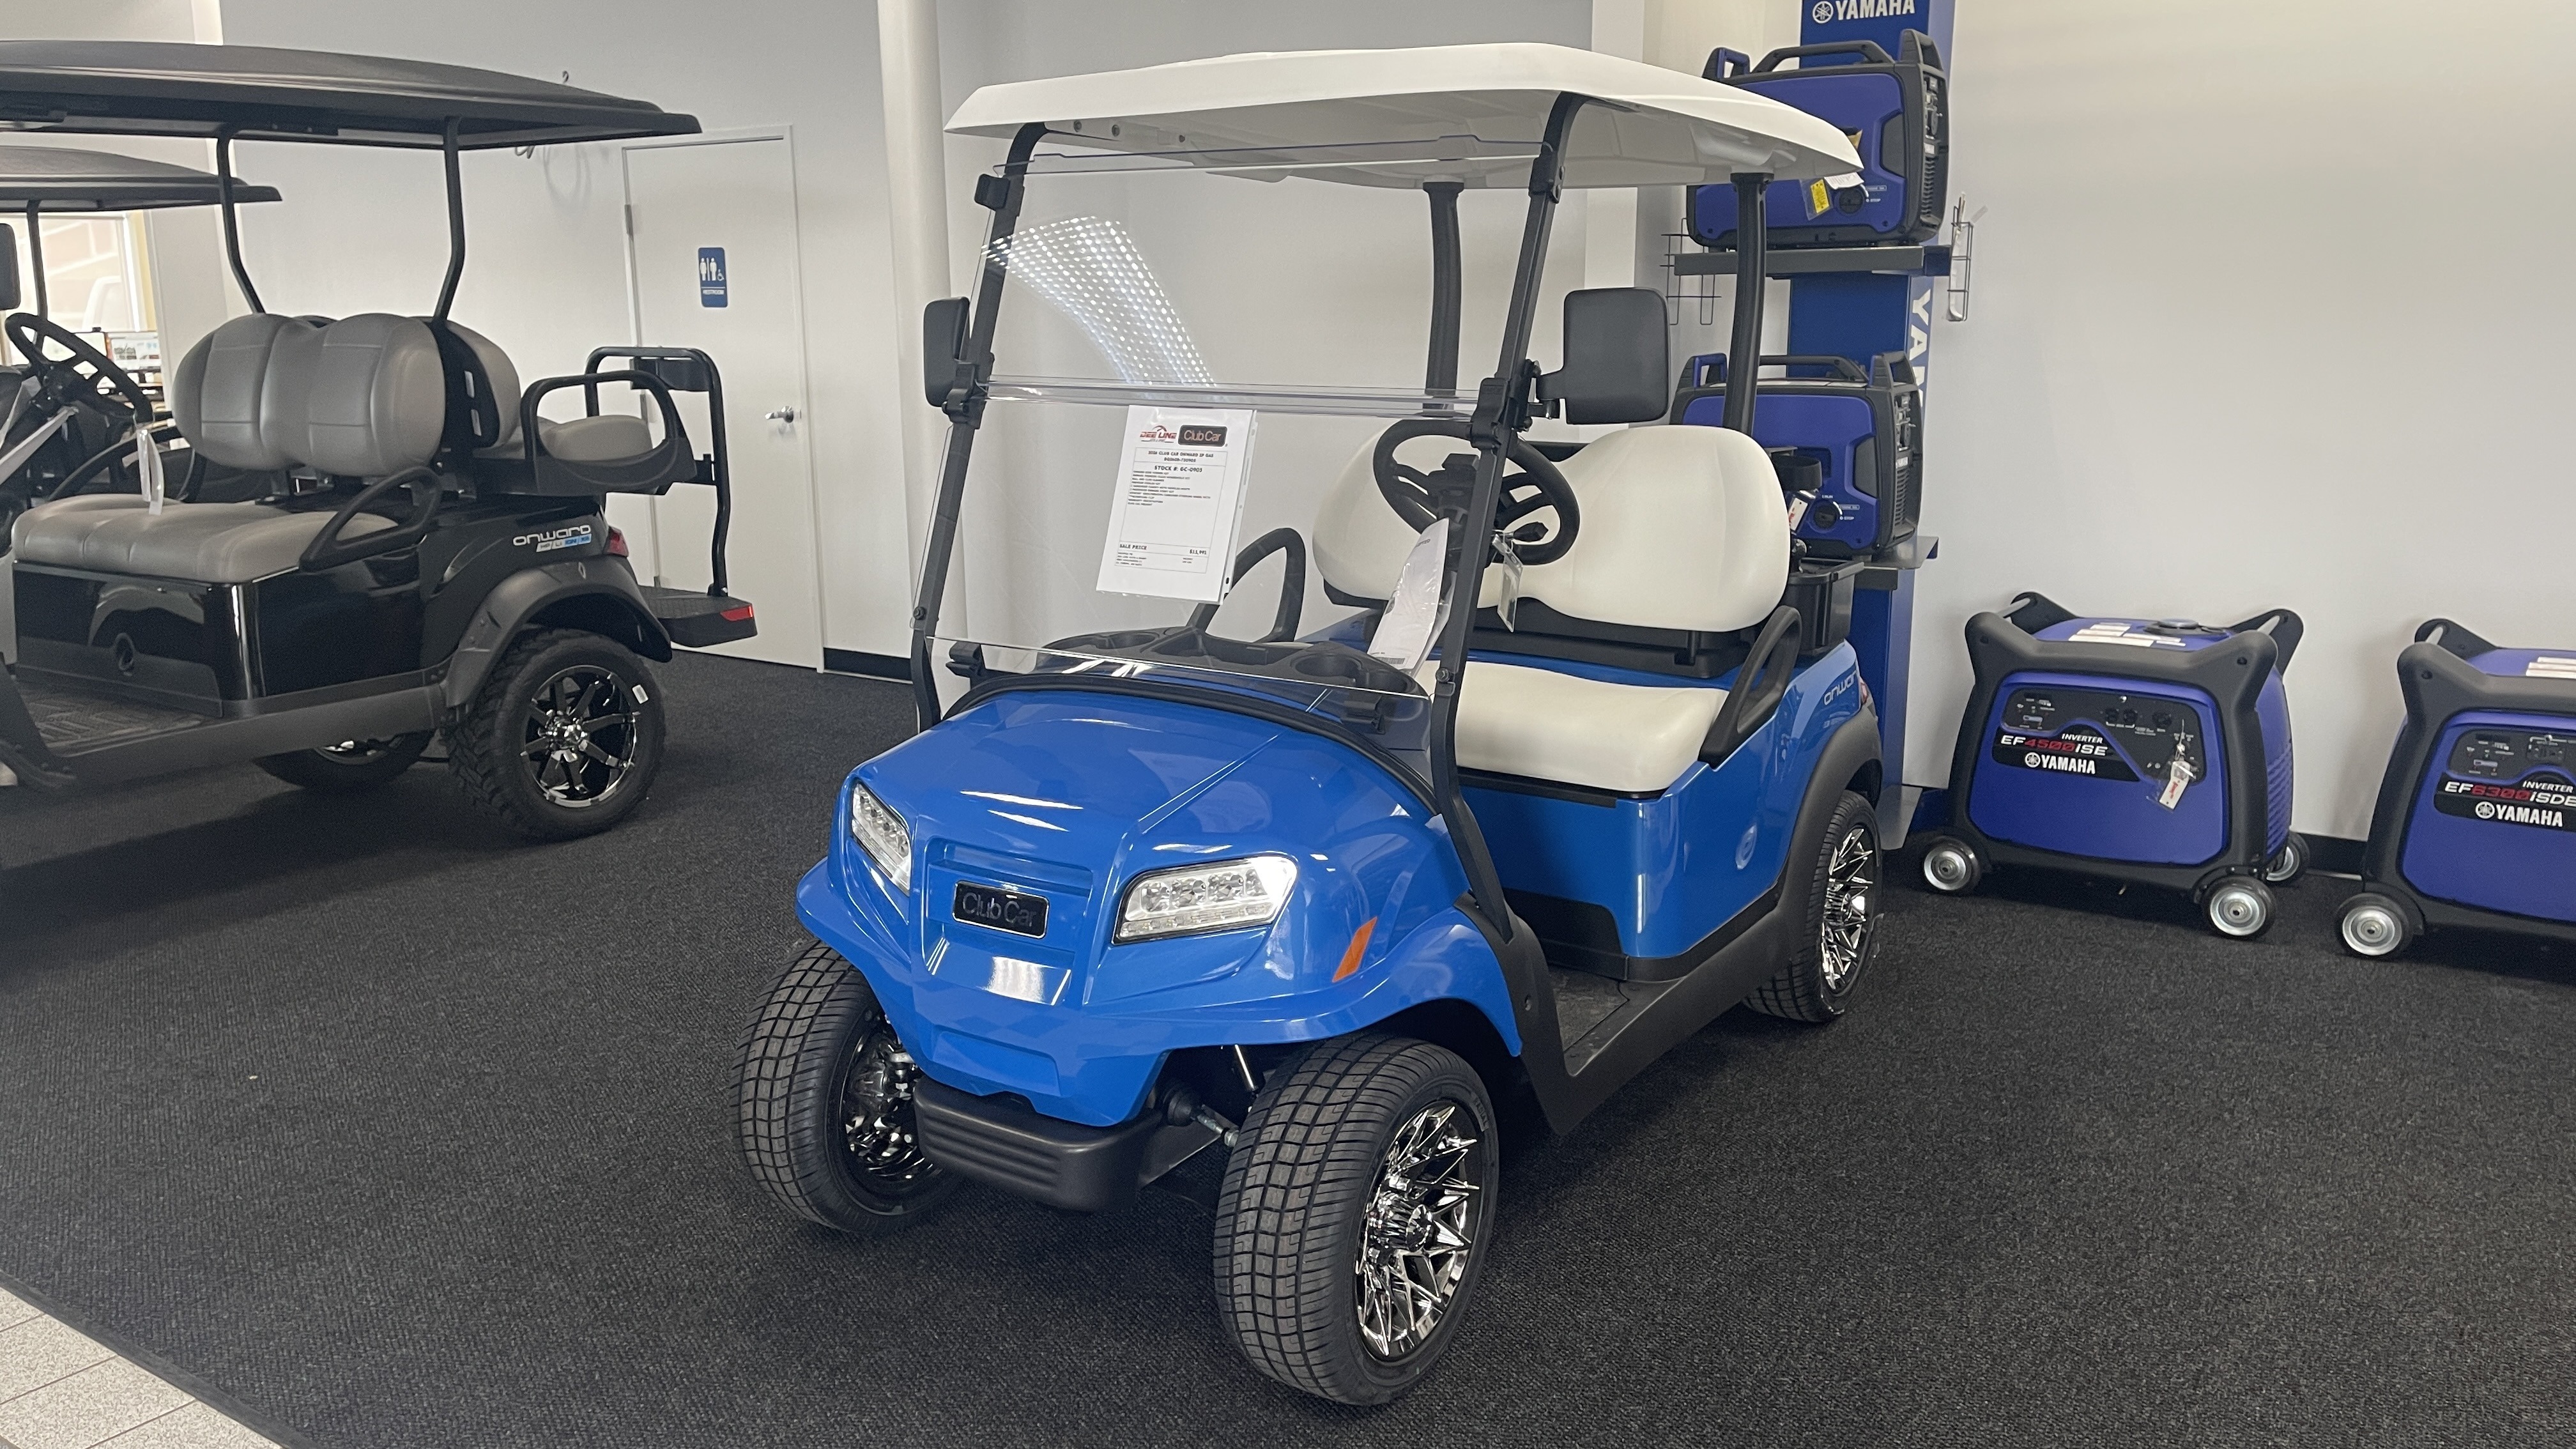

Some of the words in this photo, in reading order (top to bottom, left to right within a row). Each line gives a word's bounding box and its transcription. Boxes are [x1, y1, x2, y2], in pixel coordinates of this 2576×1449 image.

[1836, 0, 1915, 20] YAMAHA
[1184, 429, 1204, 441] Club
[1204, 431, 1222, 441] Car
[2061, 733, 2103, 744] INVERTER
[2041, 754, 2096, 774] YAMAHA
[2522, 780, 2574, 793] INVERTER
[2496, 804, 2563, 827] YAMAHA
[962, 892, 1002, 920] Club
[1004, 900, 1037, 927] Car
